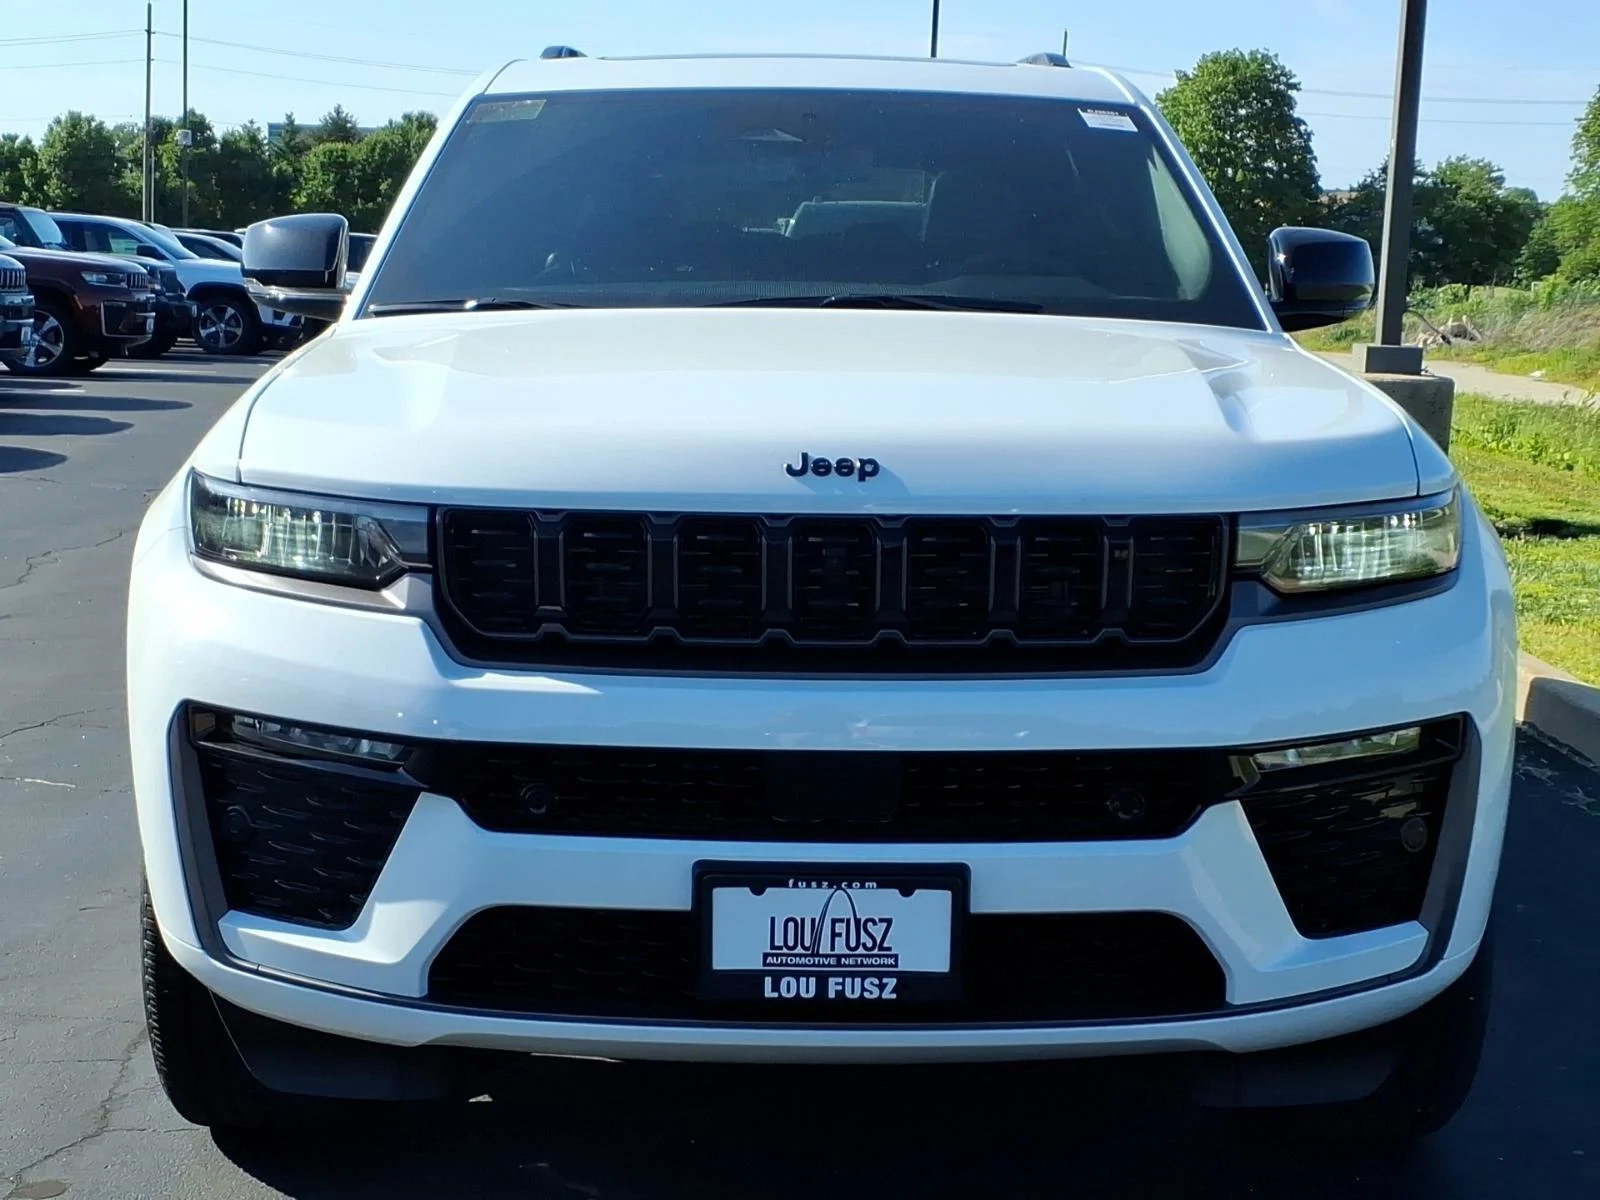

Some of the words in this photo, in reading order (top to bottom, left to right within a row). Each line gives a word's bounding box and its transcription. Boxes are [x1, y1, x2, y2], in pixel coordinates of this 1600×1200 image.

[785, 452, 880, 482] Jeep
[788, 879, 877, 889] fusz.com
[769, 916, 817, 951] LOU
[829, 917, 893, 952] FUSZ
[766, 956, 837, 965] AUTOMOTIVE
[841, 957, 896, 965] NETWORK
[764, 976, 816, 998] LOU
[828, 977, 897, 999] FUSZ
